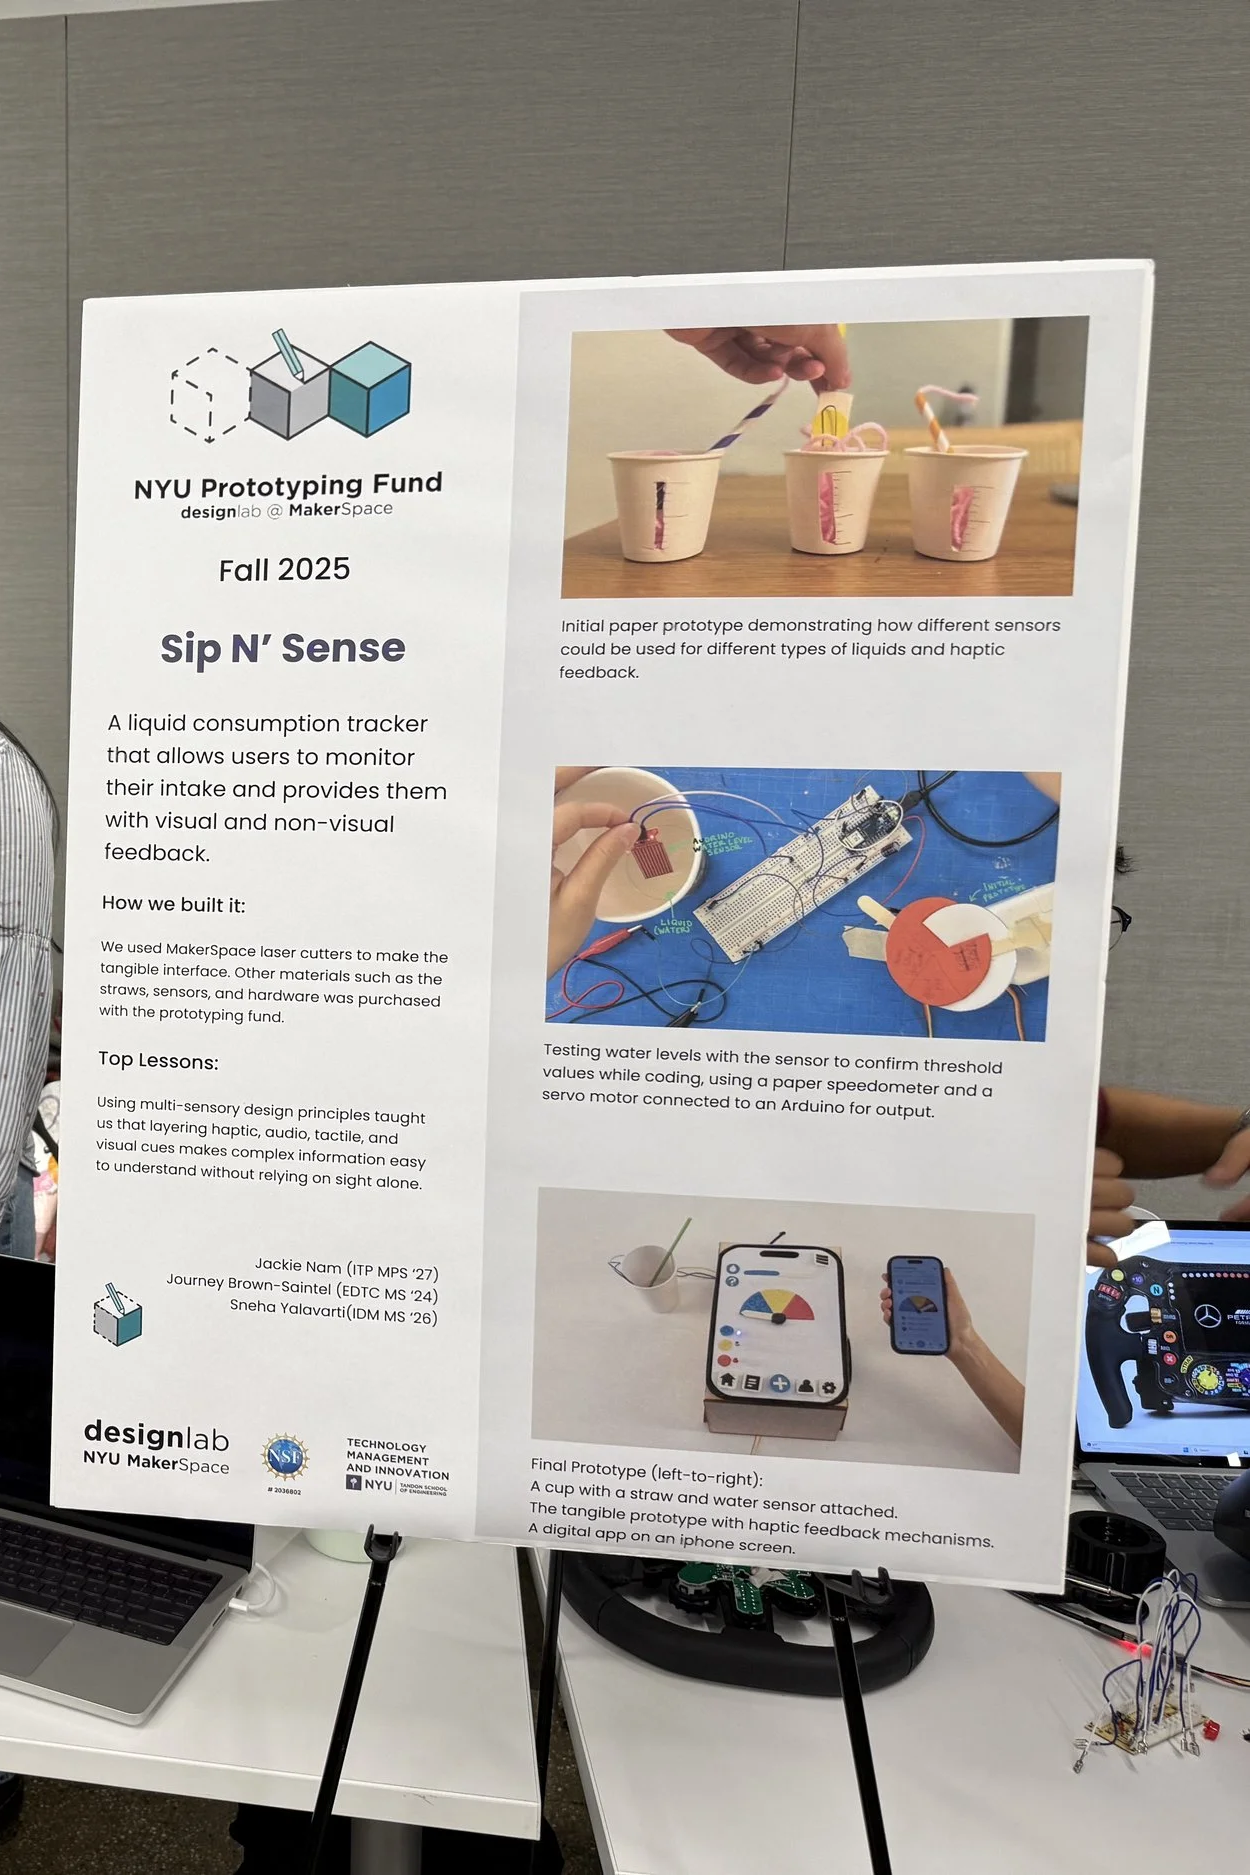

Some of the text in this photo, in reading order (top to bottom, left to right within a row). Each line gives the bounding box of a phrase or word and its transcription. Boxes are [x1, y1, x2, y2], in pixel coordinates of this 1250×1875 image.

[135, 471, 442, 500] NYU Prototyping Fund
[181, 502, 393, 521] designlab @ MakerSpace
[220, 557, 350, 582] Fall 2025
[562, 618, 1061, 636] Initial paper prototype demonstrating how different sensors
[161, 630, 221, 673] Sip
[282, 633, 406, 663] Sense
[560, 666, 639, 679] feedback.
[108, 713, 428, 737] A liquid consumption tracker
[107, 746, 415, 766] that allows users to monitor
[106, 778, 446, 804] their intake and provides them
[105, 811, 394, 832] with visual and non-visual
[707, 845, 743, 856] SENSOR
[728, 836, 753, 846] LEVEL
[105, 842, 210, 862] feedback.
[103, 895, 245, 913] How we built it:
[660, 919, 693, 927] LIQUID
[101, 941, 448, 963] We used MakerSpace laser cutters to make the
[98, 1051, 218, 1071] Top Lessons:
[544, 1043, 1003, 1074] Testing water levels with the sensor to confirm threshold
[97, 1096, 426, 1127] Using multi-sensory design principles taught
[542, 1090, 935, 1120] servo motor connected to an Arduino for output.
[96, 1160, 422, 1190] to understand without relying on sight alone.
[255, 1258, 302, 1271] Jackie
[306, 1261, 341, 1274] Nam
[347, 1260, 373, 1278] (ITP
[378, 1266, 408, 1279] MPS
[166, 1273, 224, 1291] Journey
[228, 1277, 331, 1295] Brown-Saintel
[336, 1281, 380, 1299] (EDTC
[385, 1288, 406, 1301] MS
[230, 1299, 276, 1313] Sneha
[384, 1310, 405, 1323] MS
[84, 1419, 229, 1452] designlab
[347, 1438, 426, 1453] TECHNOLOGY
[84, 1450, 229, 1474] NYU MakerSpace
[269, 1448, 303, 1465] NSF
[347, 1450, 429, 1466] MANAGEMENT
[346, 1463, 449, 1480] AND INNOVATION
[532, 1458, 763, 1489] Final Prototype (left-to-right):
[274, 1487, 301, 1495] 2036802
[364, 1479, 393, 1492] NYU
[530, 1480, 898, 1519] A cup with a straw and water sensor attached.
[528, 1523, 795, 1554] A digital app on an iphone screen.
